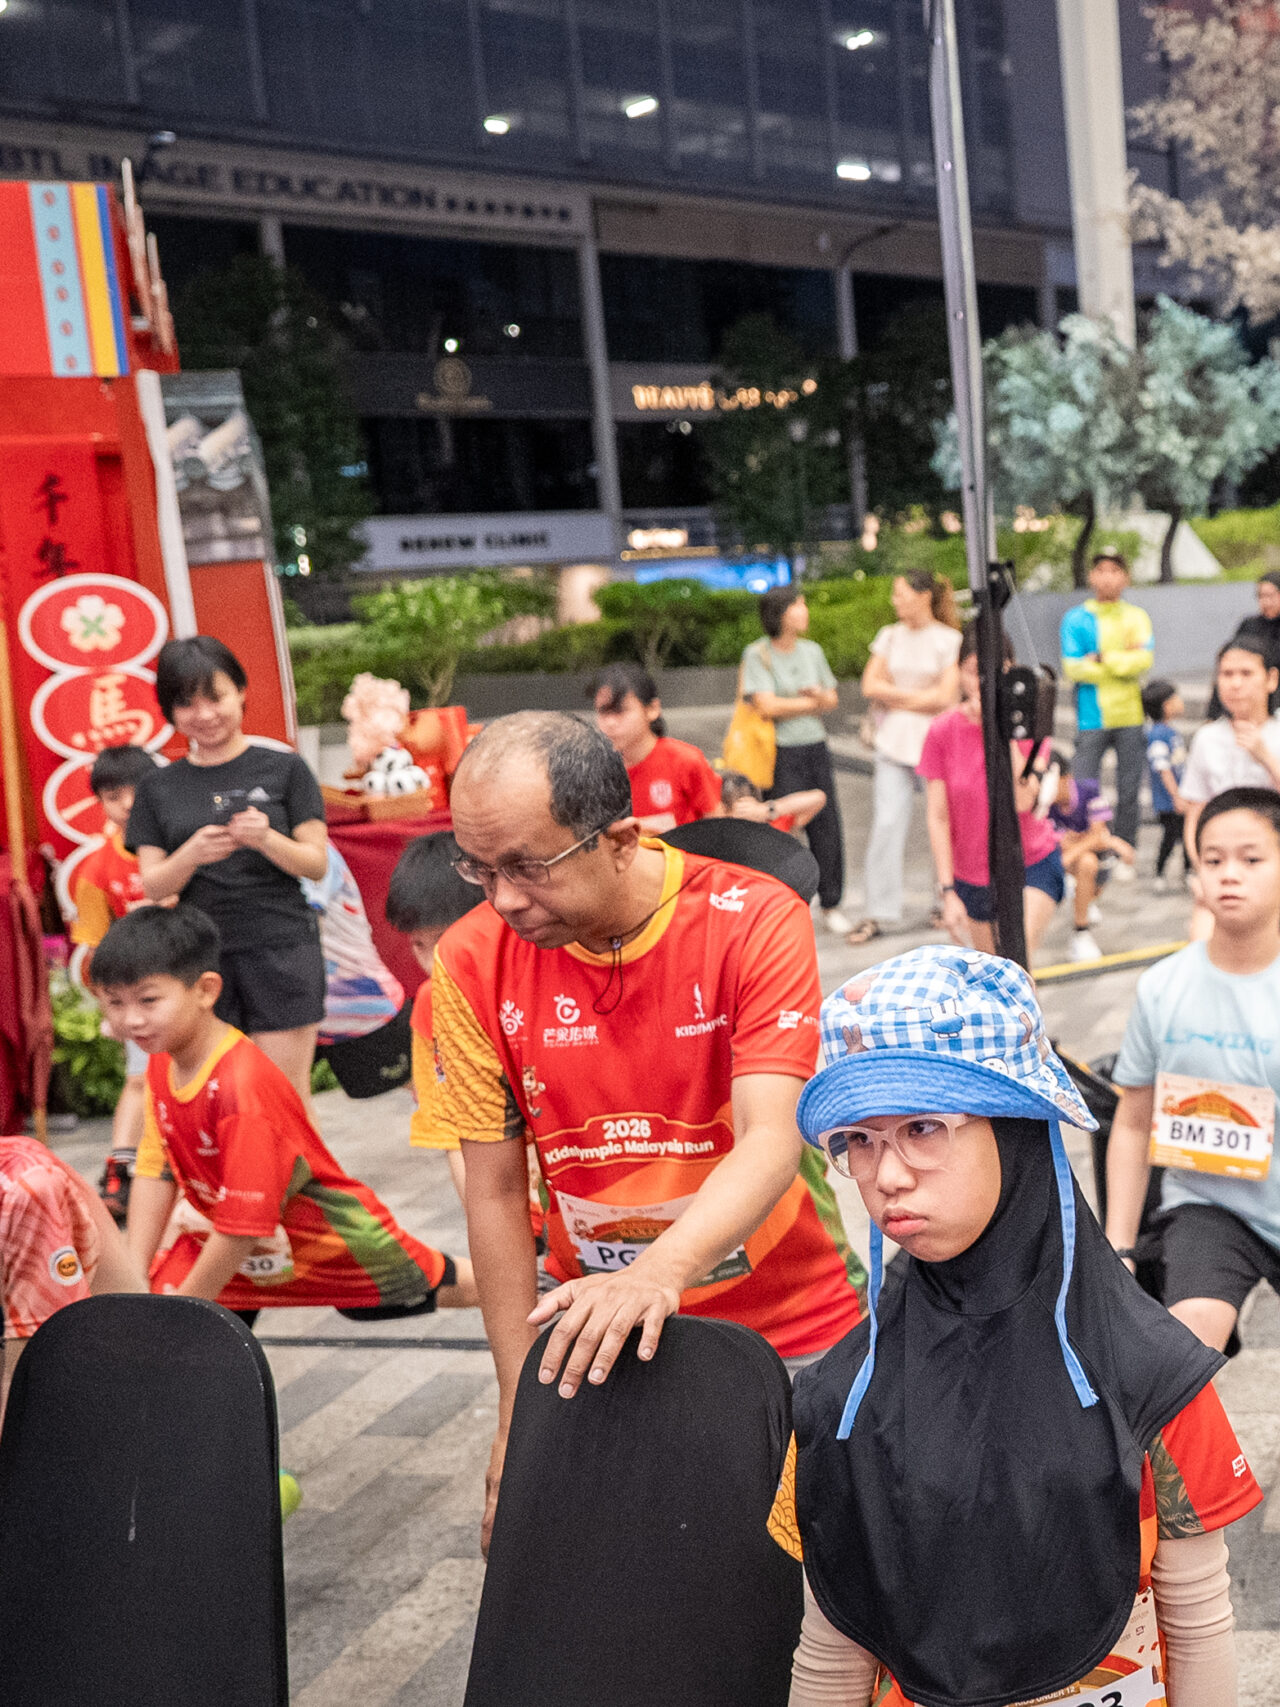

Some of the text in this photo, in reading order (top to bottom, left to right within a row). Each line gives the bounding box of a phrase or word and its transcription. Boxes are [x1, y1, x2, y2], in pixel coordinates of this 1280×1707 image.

[232, 168, 437, 211] EDUCATION
[602, 1118, 651, 1140] 2026
[1170, 1121, 1252, 1151] BM 301
[624, 1138, 683, 1156] Malaysia
[684, 1140, 715, 1154] Run
